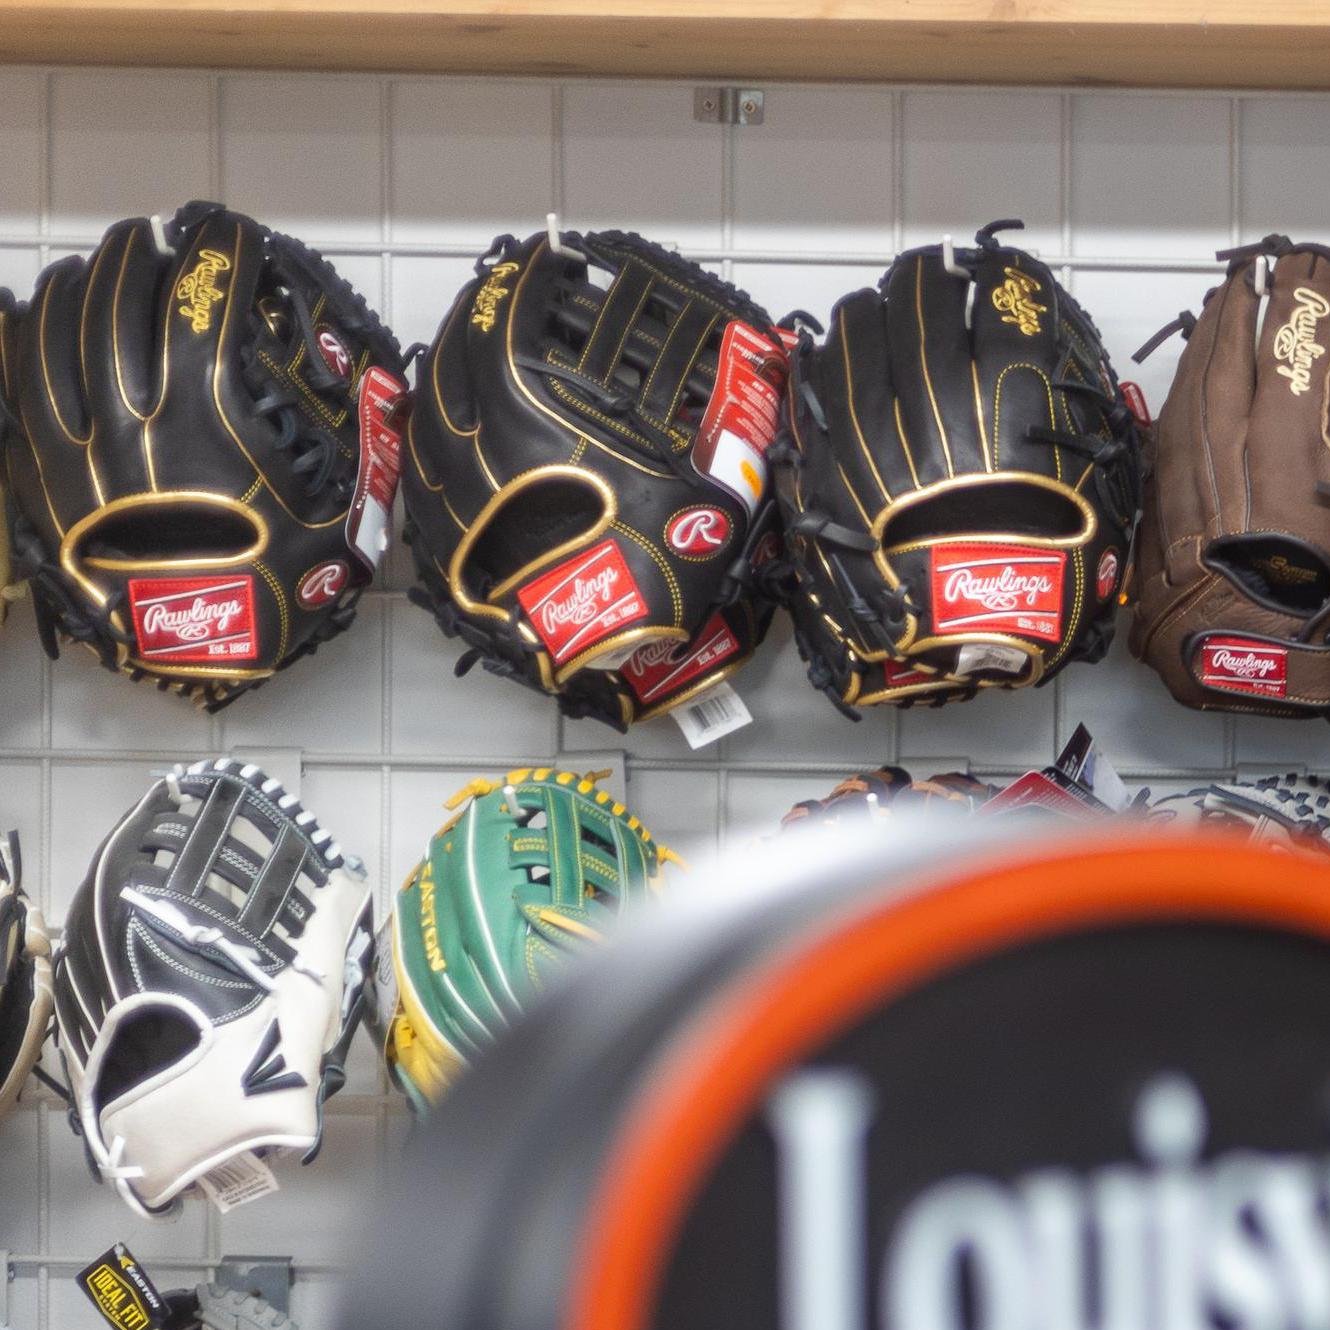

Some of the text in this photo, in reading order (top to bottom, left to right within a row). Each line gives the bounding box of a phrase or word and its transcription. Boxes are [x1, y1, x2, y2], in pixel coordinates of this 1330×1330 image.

[1277, 287, 1330, 396] Rawlings
[671, 510, 722, 550] R
[542, 566, 619, 634] Rawlings
[944, 566, 1053, 606] Rawlings
[144, 598, 242, 634] Rawlings
[1212, 649, 1277, 680] Rawlings
[93, 1270, 144, 1328] IDEAL FIT
[126, 1266, 160, 1309] EASTON
